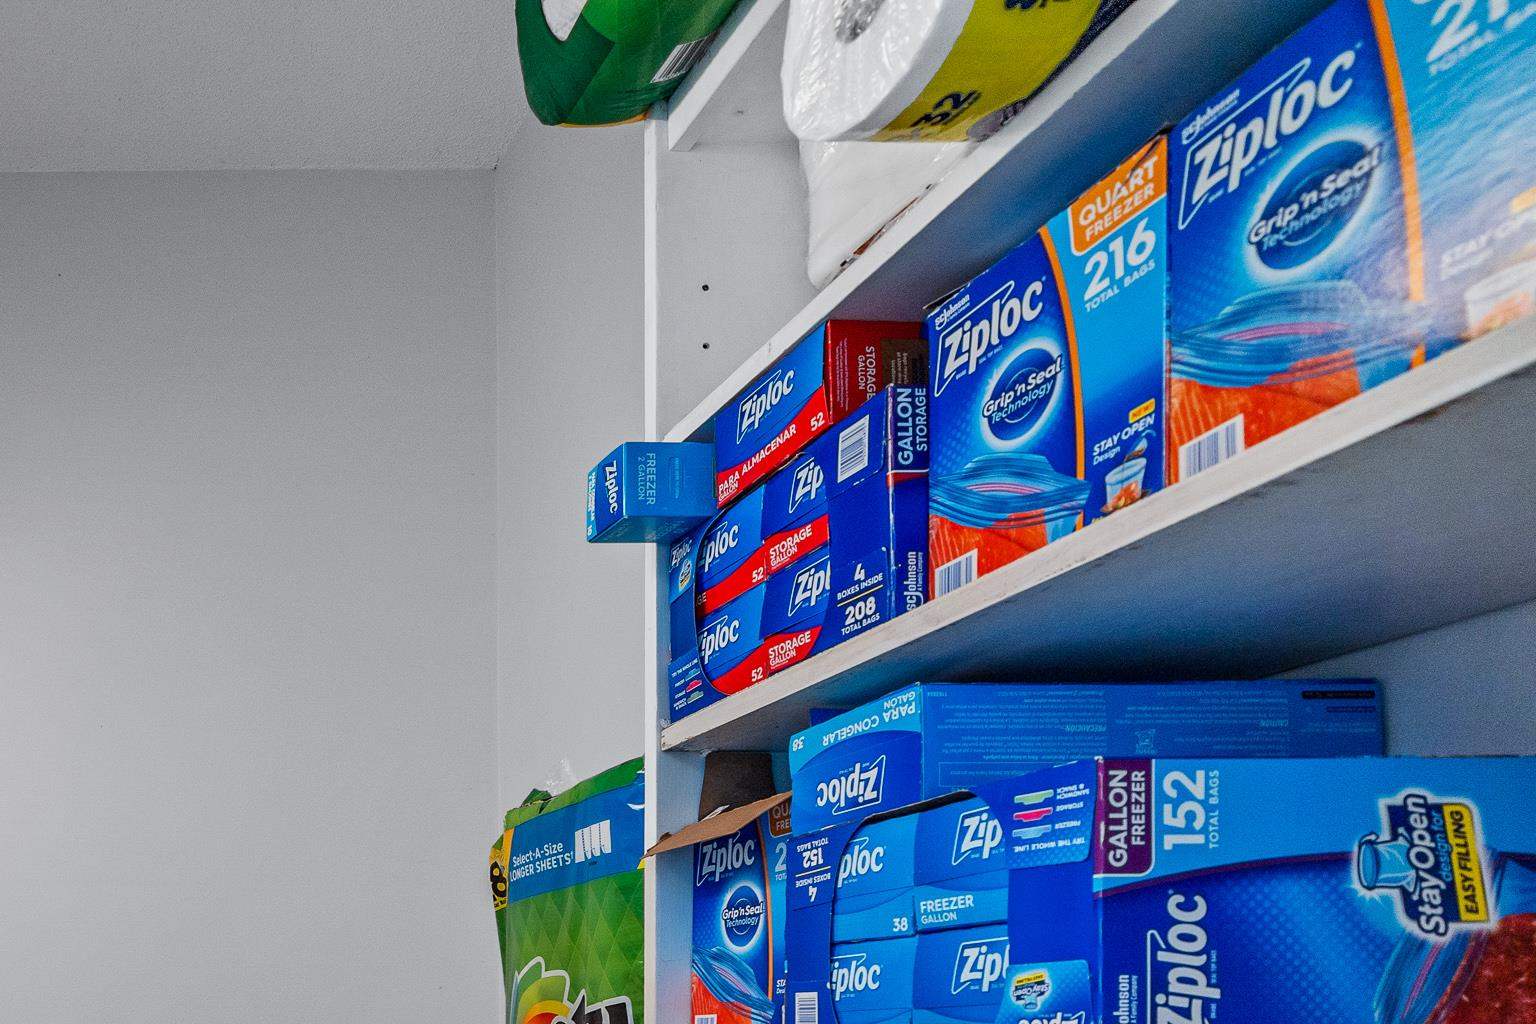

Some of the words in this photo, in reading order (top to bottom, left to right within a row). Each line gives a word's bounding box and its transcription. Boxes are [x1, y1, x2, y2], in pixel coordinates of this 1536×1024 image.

[1192, 50, 1355, 204] Ziploc
[1079, 156, 1157, 226] QUART
[1085, 183, 1154, 241] FREEZER
[1083, 216, 1157, 302] 216
[1085, 284, 1120, 312] TOTAL
[1123, 259, 1156, 287] BAGS
[944, 281, 1043, 379] Ziploc
[858, 355, 866, 390] GALLON
[1027, 356, 1062, 389] Seal
[742, 370, 795, 430] Ziploc
[991, 380, 1053, 423] Technology
[811, 412, 825, 431] 52
[897, 388, 913, 465] GALLON
[915, 388, 927, 451] STORAGE
[1093, 432, 1121, 456] STAY
[1121, 413, 1155, 440] OPEN
[718, 471, 740, 494] PARA
[742, 424, 796, 475] ALMACENAR
[1093, 446, 1120, 466] Design
[606, 461, 618, 513] Ziploc
[647, 453, 655, 505] FREEZER
[795, 460, 824, 500] Zip
[702, 525, 740, 572] iploc
[769, 524, 812, 559] STORAGE
[770, 545, 797, 568] GALLON
[752, 567, 764, 582] 52
[837, 584, 860, 600] BOXES
[860, 573, 883, 589] INSIDE
[854, 563, 865, 581] 4
[841, 621, 861, 635] TOTAL
[862, 613, 880, 627] BAGS
[845, 596, 876, 625] 208
[700, 619, 740, 664] iploc
[768, 631, 811, 661] STORAGE
[769, 643, 796, 667] GALLON
[752, 667, 763, 682] 52
[883, 702, 916, 722] PARA
[792, 736, 805, 752] 38
[822, 715, 879, 747] CONGELAR
[817, 762, 879, 807] Ziploc
[1209, 770, 1219, 804] BAGS
[1109, 770, 1128, 867] GALLON
[1131, 770, 1146, 845] FREEZER
[1163, 770, 1206, 850] 152
[1431, 808, 1443, 831] for
[797, 841, 810, 853] BAGS
[810, 837, 828, 848] TOTAL
[961, 812, 1003, 859] Zip
[1032, 841, 1056, 850] WHOLE
[1209, 810, 1219, 849] TOTAL
[1405, 795, 1436, 869] Open
[1450, 810, 1472, 872] FILLING
[512, 842, 563, 867] Select-A-Size
[702, 841, 755, 882] Ziploc
[803, 847, 823, 868] 152
[838, 844, 885, 887] ploc
[1436, 833, 1452, 881] design
[510, 866, 534, 882] LONGER
[795, 877, 813, 888] INSIDE
[813, 872, 831, 883] BOXES
[745, 902, 762, 914] Seal
[809, 885, 818, 902] 4
[920, 895, 974, 914] FREEZER
[1418, 870, 1447, 935] Stay
[1460, 873, 1479, 914] EASY
[726, 916, 759, 928] Technology
[892, 918, 908, 932] 38
[921, 912, 957, 925] GALLON
[832, 960, 881, 1001] iploc
